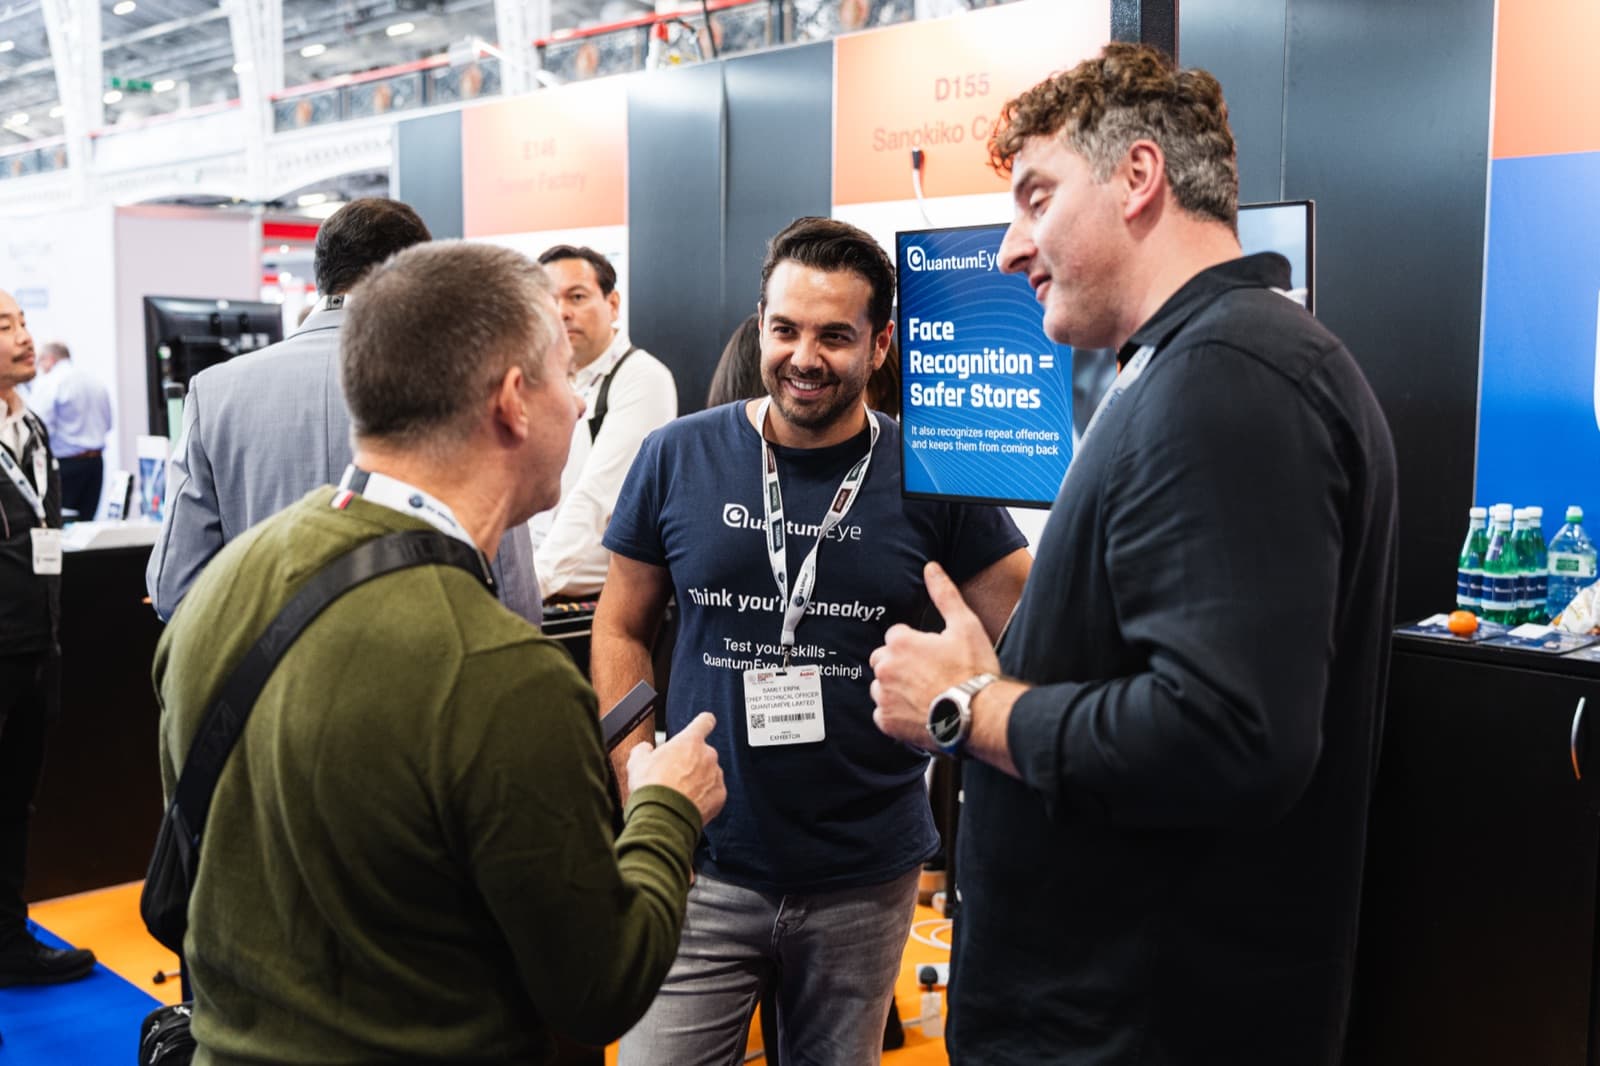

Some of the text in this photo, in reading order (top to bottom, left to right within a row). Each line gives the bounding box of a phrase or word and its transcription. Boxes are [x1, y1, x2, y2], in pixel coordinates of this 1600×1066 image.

[935, 72, 990, 101] D155
[872, 121, 965, 152] Sanokiko
[909, 318, 954, 341] Face
[909, 347, 1054, 379] Recognition =
[910, 381, 1041, 409] Safer Stores
[911, 425, 1060, 441] It also recognizes repeat offenders
[911, 440, 1059, 456] and keeps them from coming back
[723, 503, 861, 542] QuatumEye
[688, 588, 886, 622] Think you'r sneaky?
[723, 637, 752, 653] Test
[755, 643, 786, 657] your
[791, 644, 826, 659] skills
[819, 663, 862, 680] tching!
[795, 691, 819, 699] OFFICER
